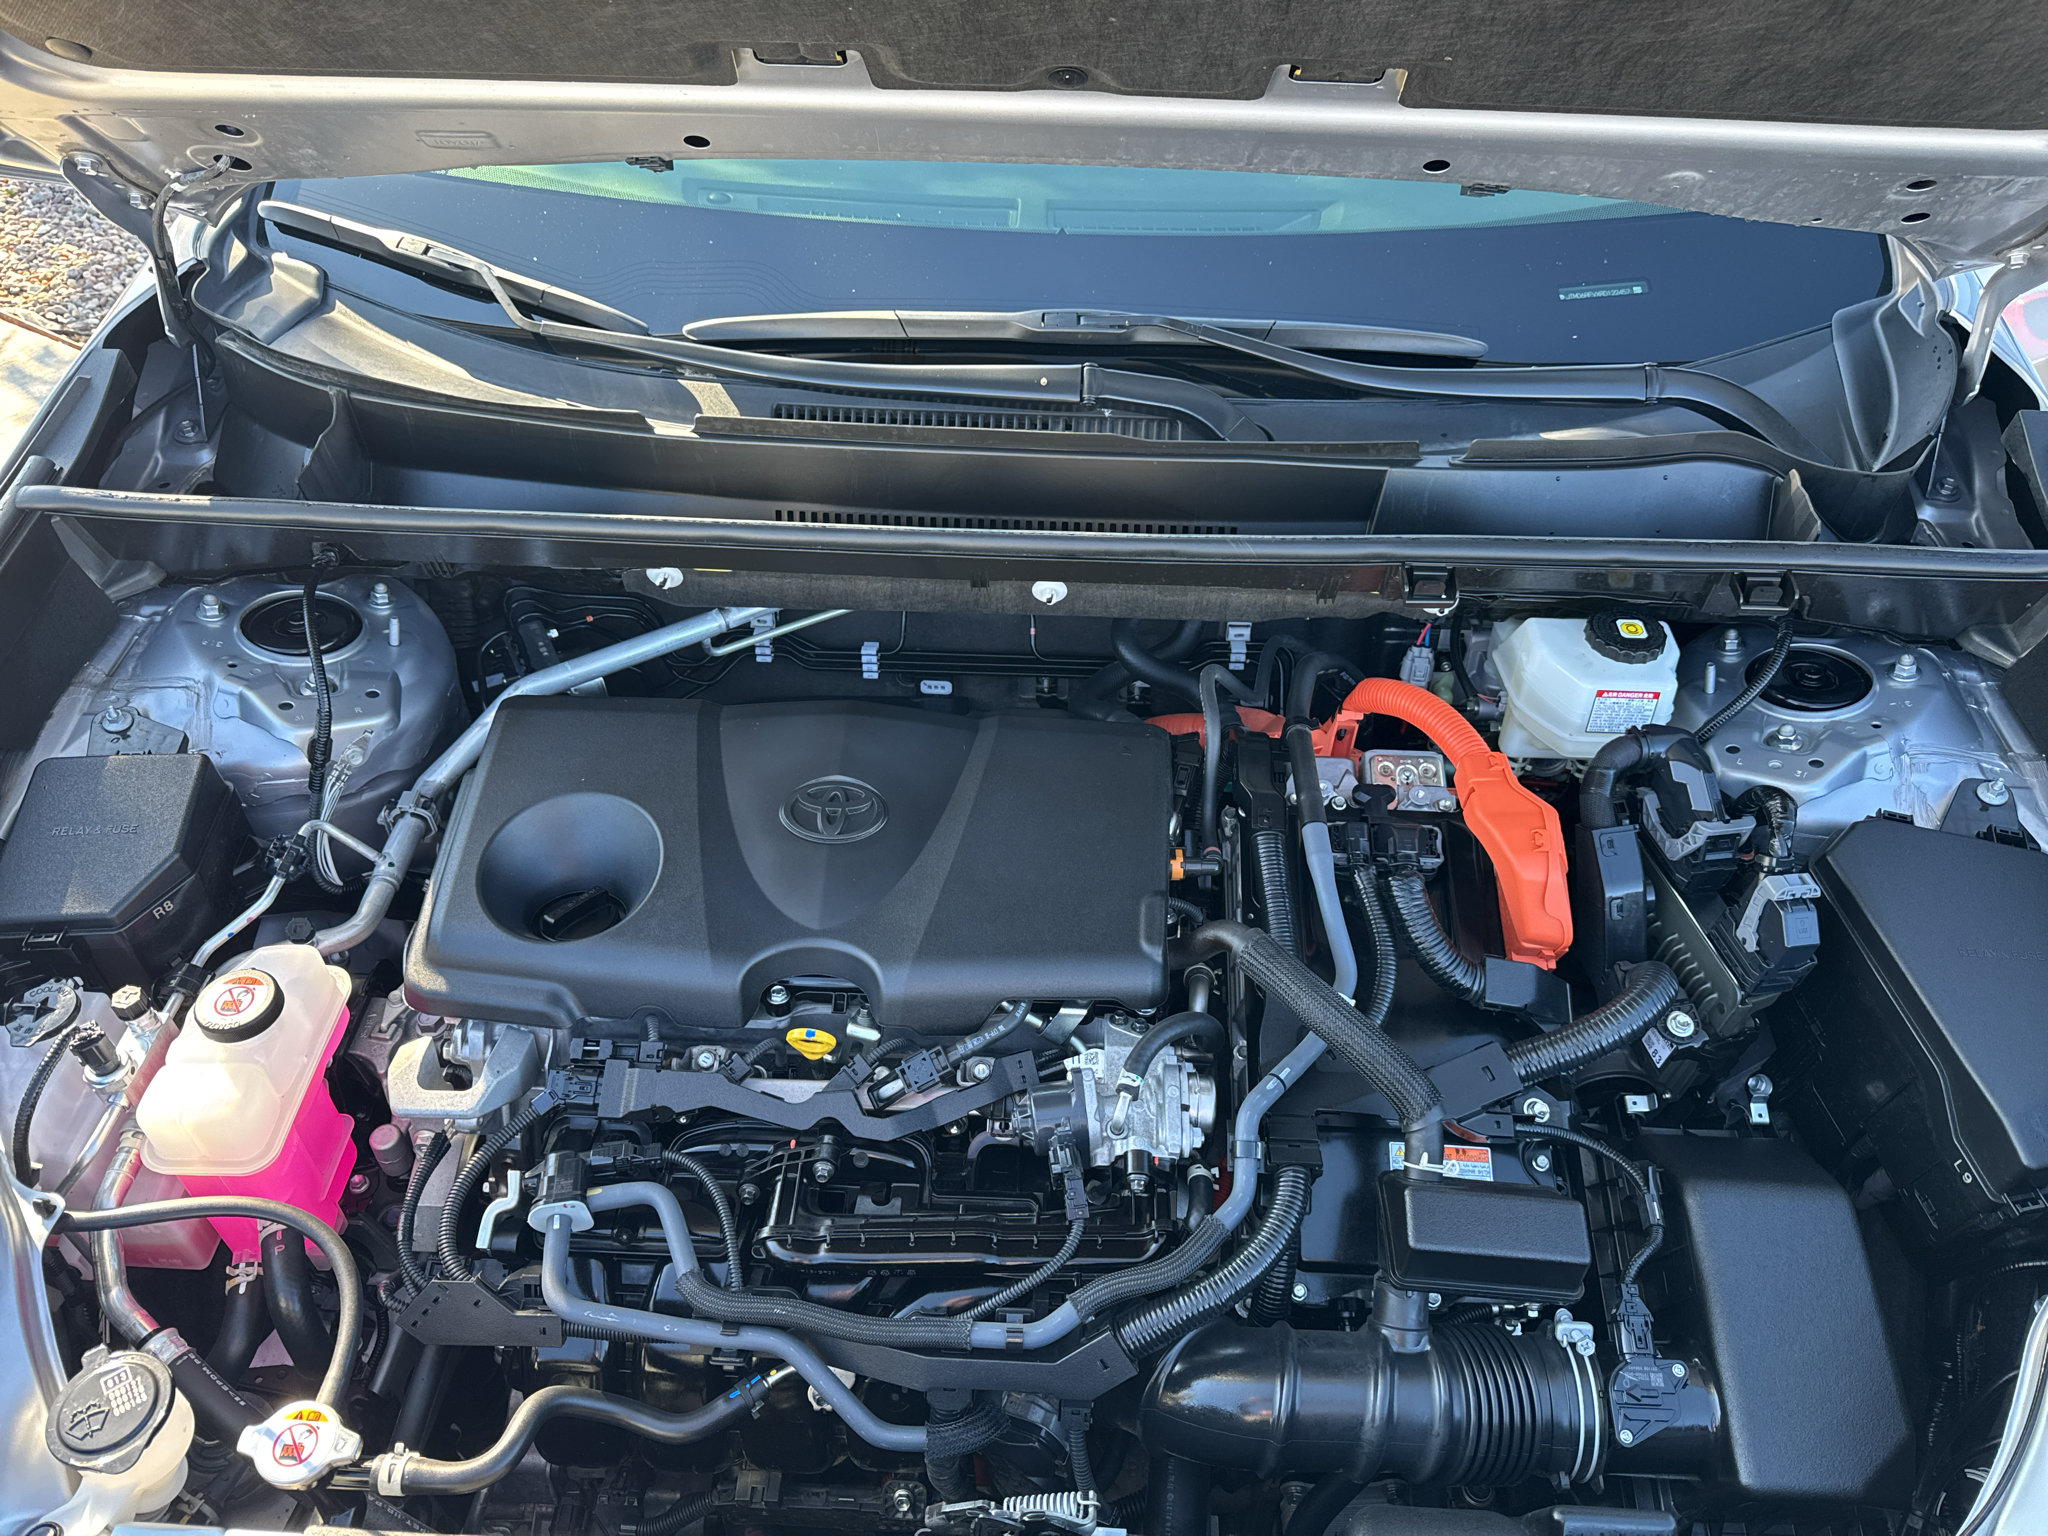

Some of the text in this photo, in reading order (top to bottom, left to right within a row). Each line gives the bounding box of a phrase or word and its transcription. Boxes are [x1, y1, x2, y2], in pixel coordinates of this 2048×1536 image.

[51, 826, 92, 837] RELAY
[105, 824, 140, 835] FUSE
[152, 900, 174, 920] R8
[1651, 1048, 1662, 1064] 83
